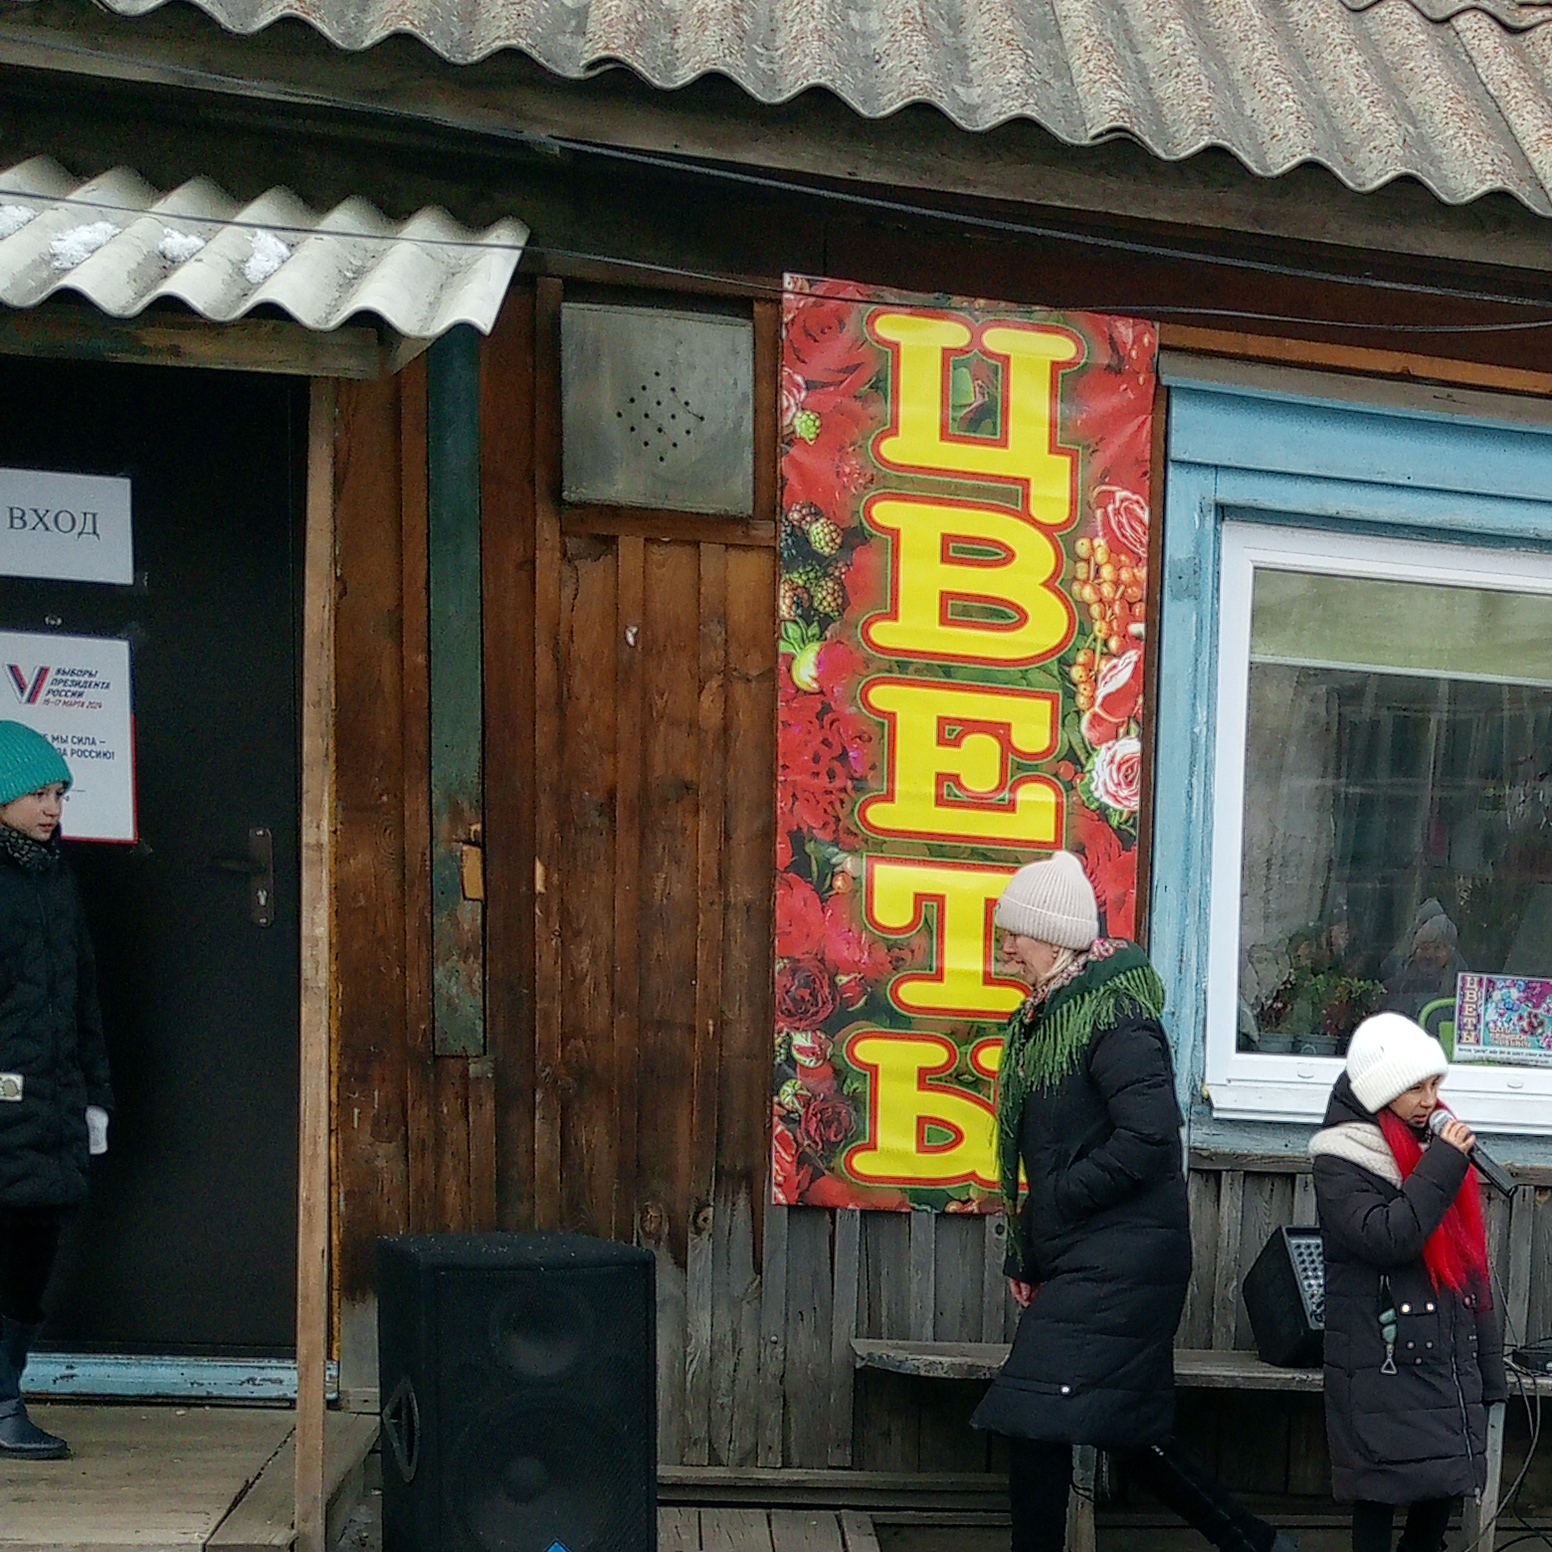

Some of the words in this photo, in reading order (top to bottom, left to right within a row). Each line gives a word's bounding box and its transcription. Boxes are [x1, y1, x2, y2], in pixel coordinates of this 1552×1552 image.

[7, 505, 101, 541] ВХОД
[55, 667, 98, 678] ВЫБОРЫ
[50, 678, 111, 690] ПРЕЗИДЕНТА
[45, 689, 85, 699] РОССИИ
[51, 734, 69, 744] МЫ
[70, 735, 97, 746] СИЛА
[70, 748, 115, 760] РОССИЮ!
[845, 308, 1088, 1190] ЦВЕТЫ
[1462, 976, 1479, 1044] ЦВЕТЫ
